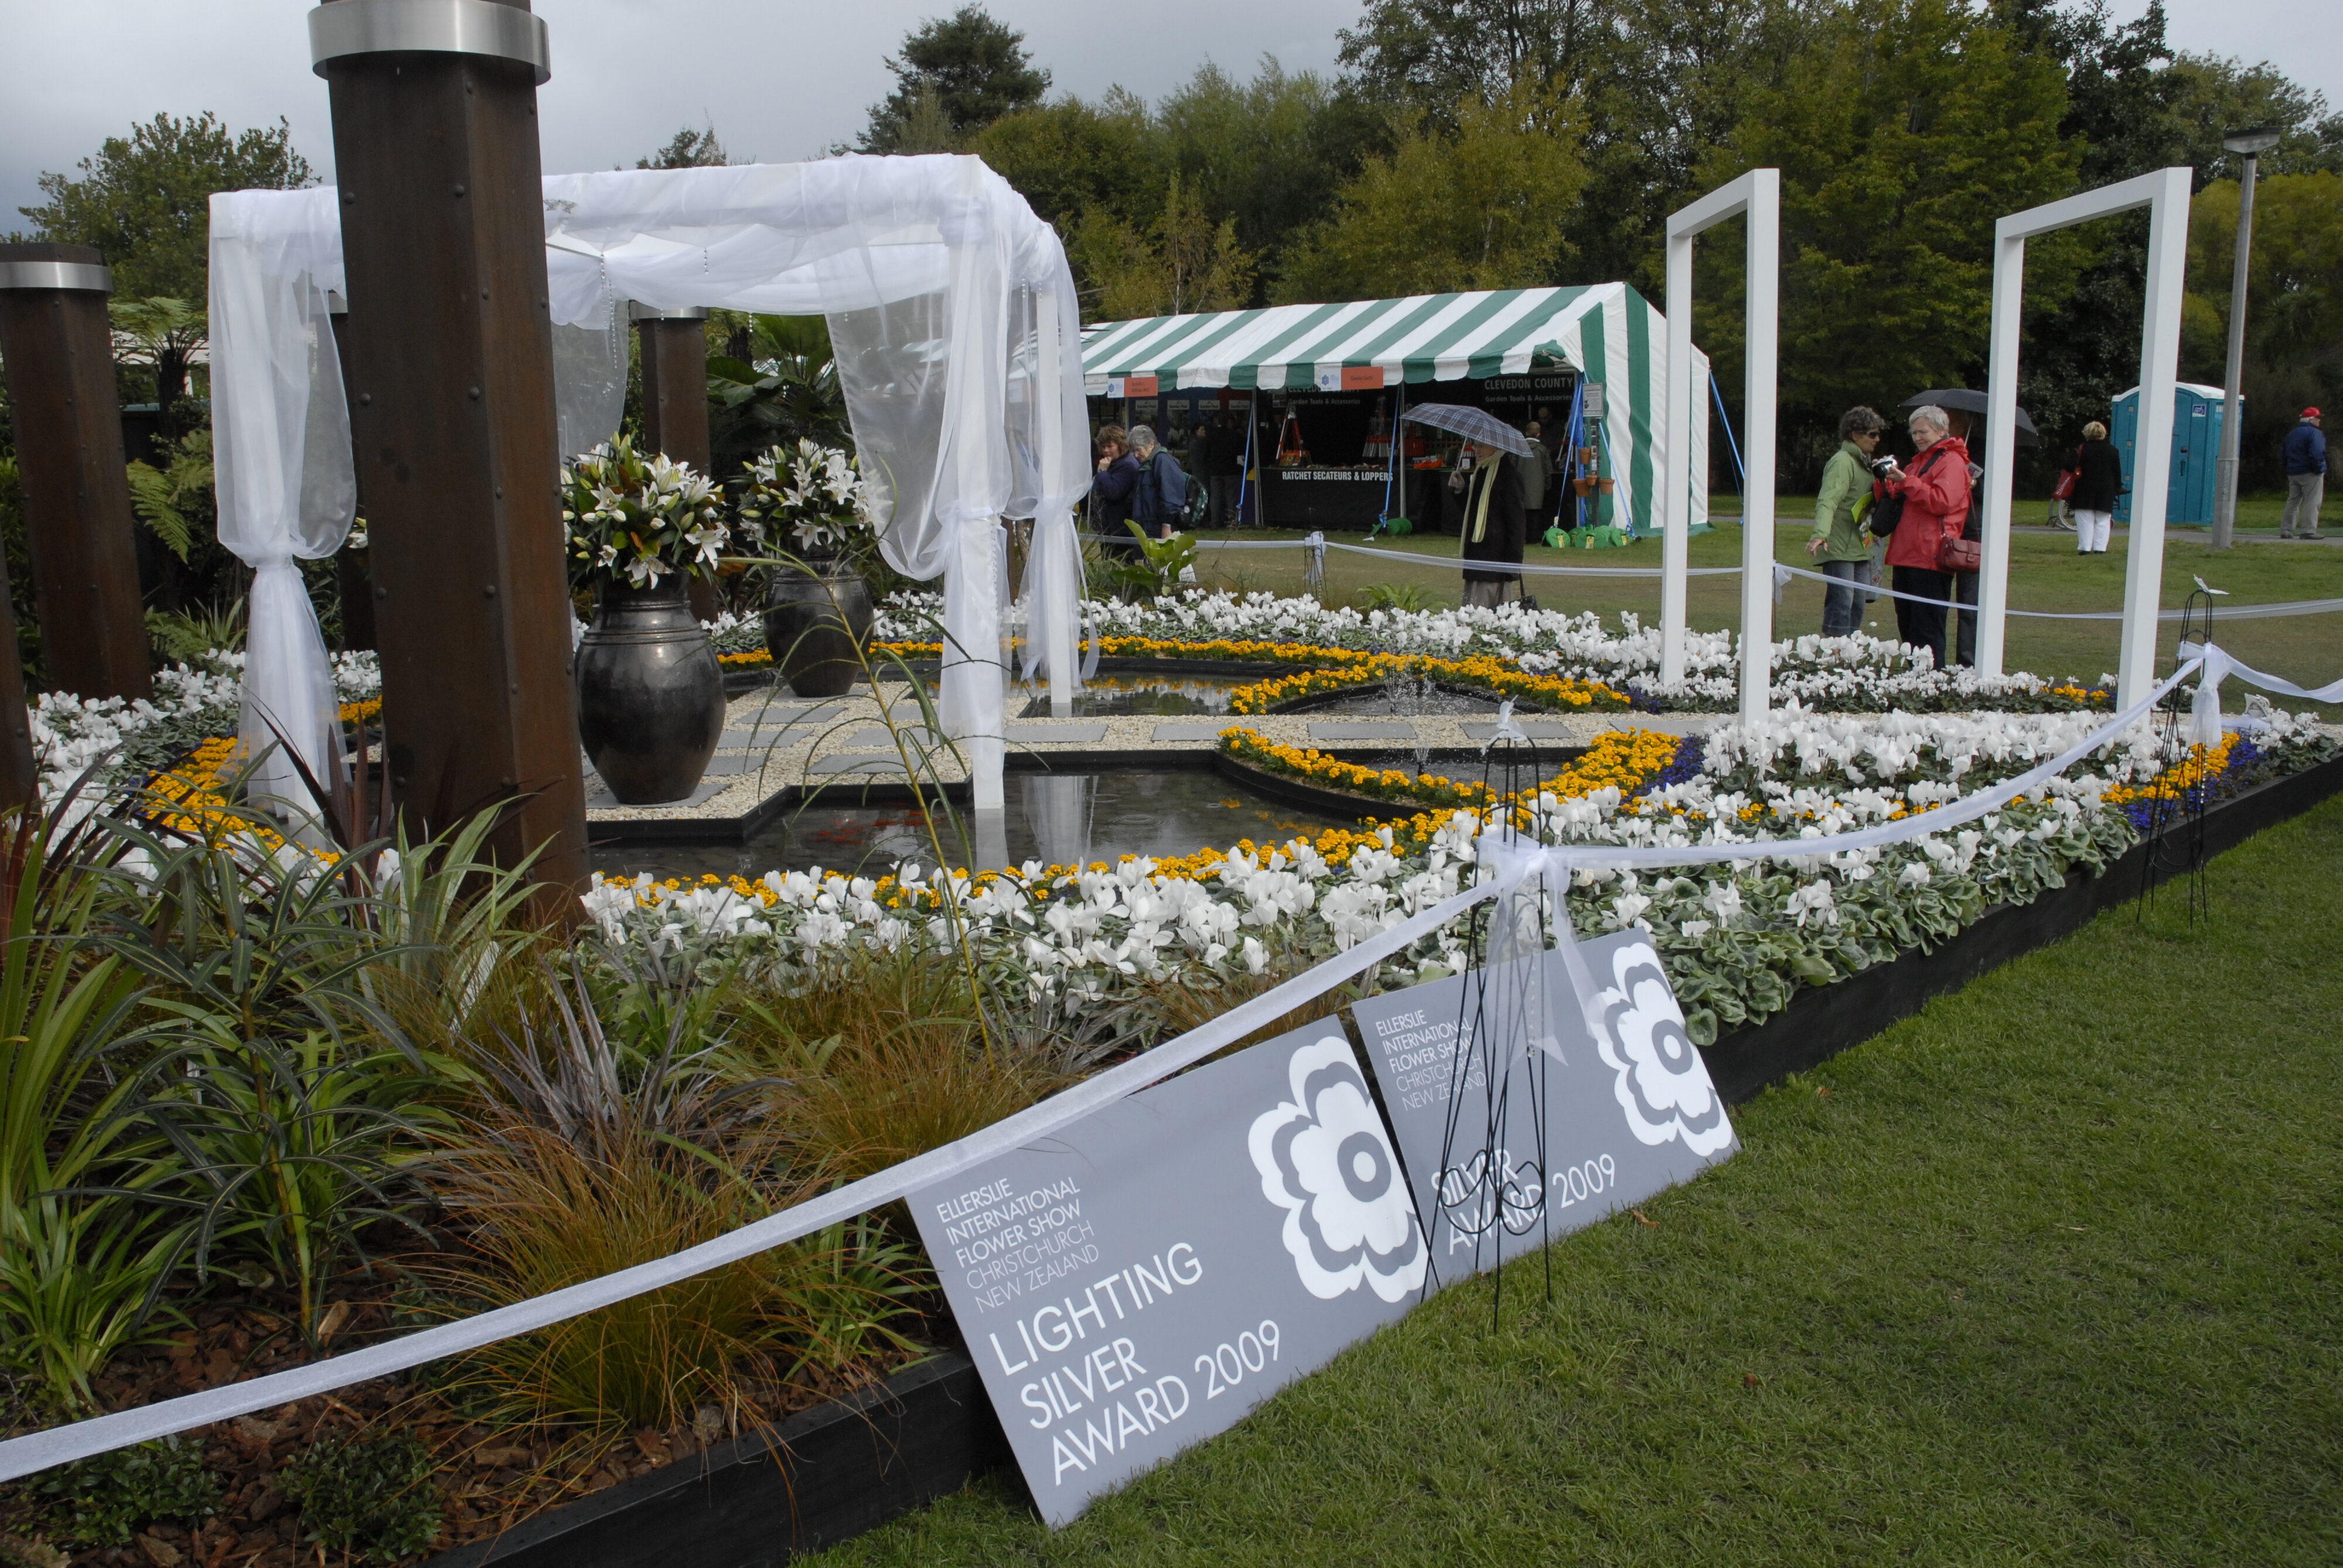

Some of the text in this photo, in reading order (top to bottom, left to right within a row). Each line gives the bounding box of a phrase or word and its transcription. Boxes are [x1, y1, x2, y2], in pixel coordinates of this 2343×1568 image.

[1485, 377, 1573, 390] CLEVEDON COUNTY
[1282, 471, 1393, 481] RATCHET SECATEURS & LOPPERS
[1376, 1009, 1427, 1037] ELLERSLIE
[1382, 1017, 1473, 1055] INTERNATIONAL
[1389, 1034, 1473, 1074] FLOWER SHOW
[1396, 1052, 1483, 1092] CHRISTCHURCH
[1402, 1071, 1486, 1111] NEW ZEALAND
[937, 1178, 1013, 1223] ELLERSLIE
[1431, 1148, 1519, 1209] SILVER
[1449, 1153, 1615, 1255] AWARD 2009
[946, 1177, 1080, 1245] INTERNATIONAL
[956, 1198, 1080, 1268] FLOWER SHOW
[967, 1219, 1094, 1289] CHRISTCHURCH
[975, 1244, 1099, 1313] NEW ZEALAND
[989, 1242, 1203, 1376] LIGHTING
[1020, 1337, 1148, 1429] SILVER
[1052, 1319, 1280, 1487] AWARD 2009
